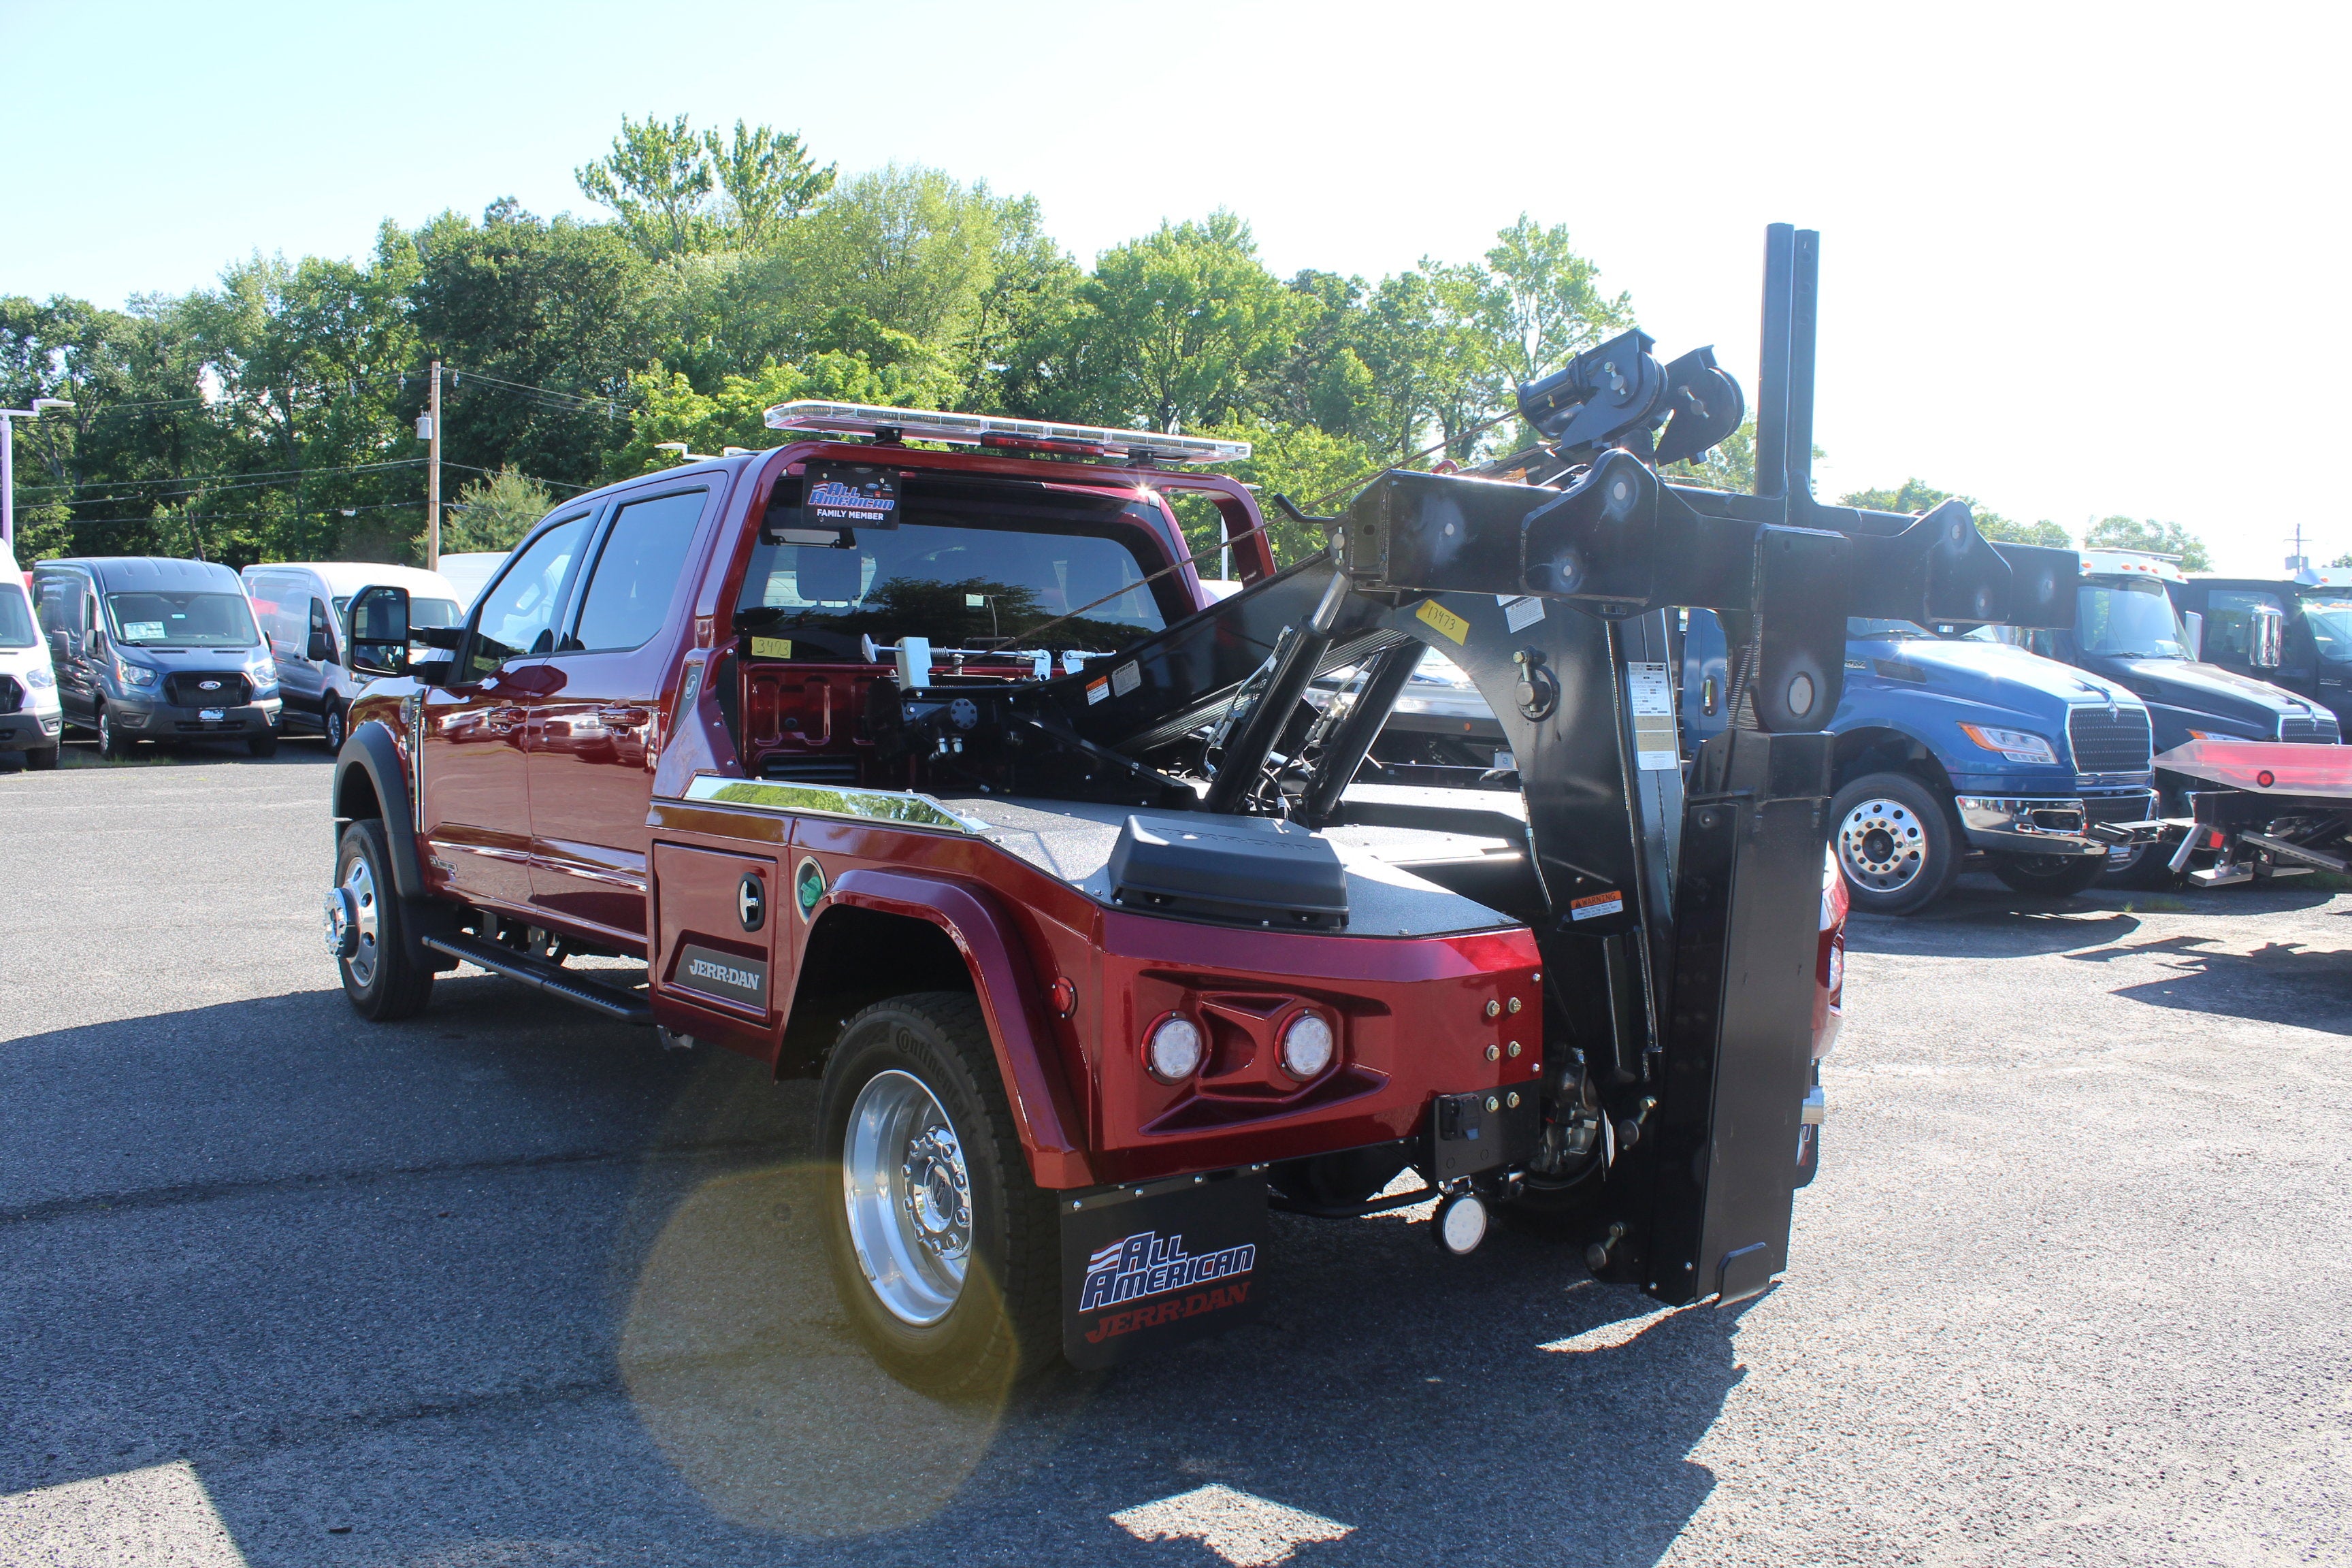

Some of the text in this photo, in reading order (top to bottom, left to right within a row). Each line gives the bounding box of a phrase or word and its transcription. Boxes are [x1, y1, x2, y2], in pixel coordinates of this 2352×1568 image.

[826, 482, 861, 497] ALL
[808, 491, 895, 510] AMERICAN
[817, 508, 884, 521] FAMILY MEMBER
[1428, 606, 1456, 630] 13473
[756, 639, 789, 656] 3473
[1582, 893, 1616, 906] WARNING
[1117, 1231, 1188, 1275] ALL
[1079, 1244, 1256, 1312] AMERICAN
[1085, 1281, 1251, 1343] JERR-DAN
